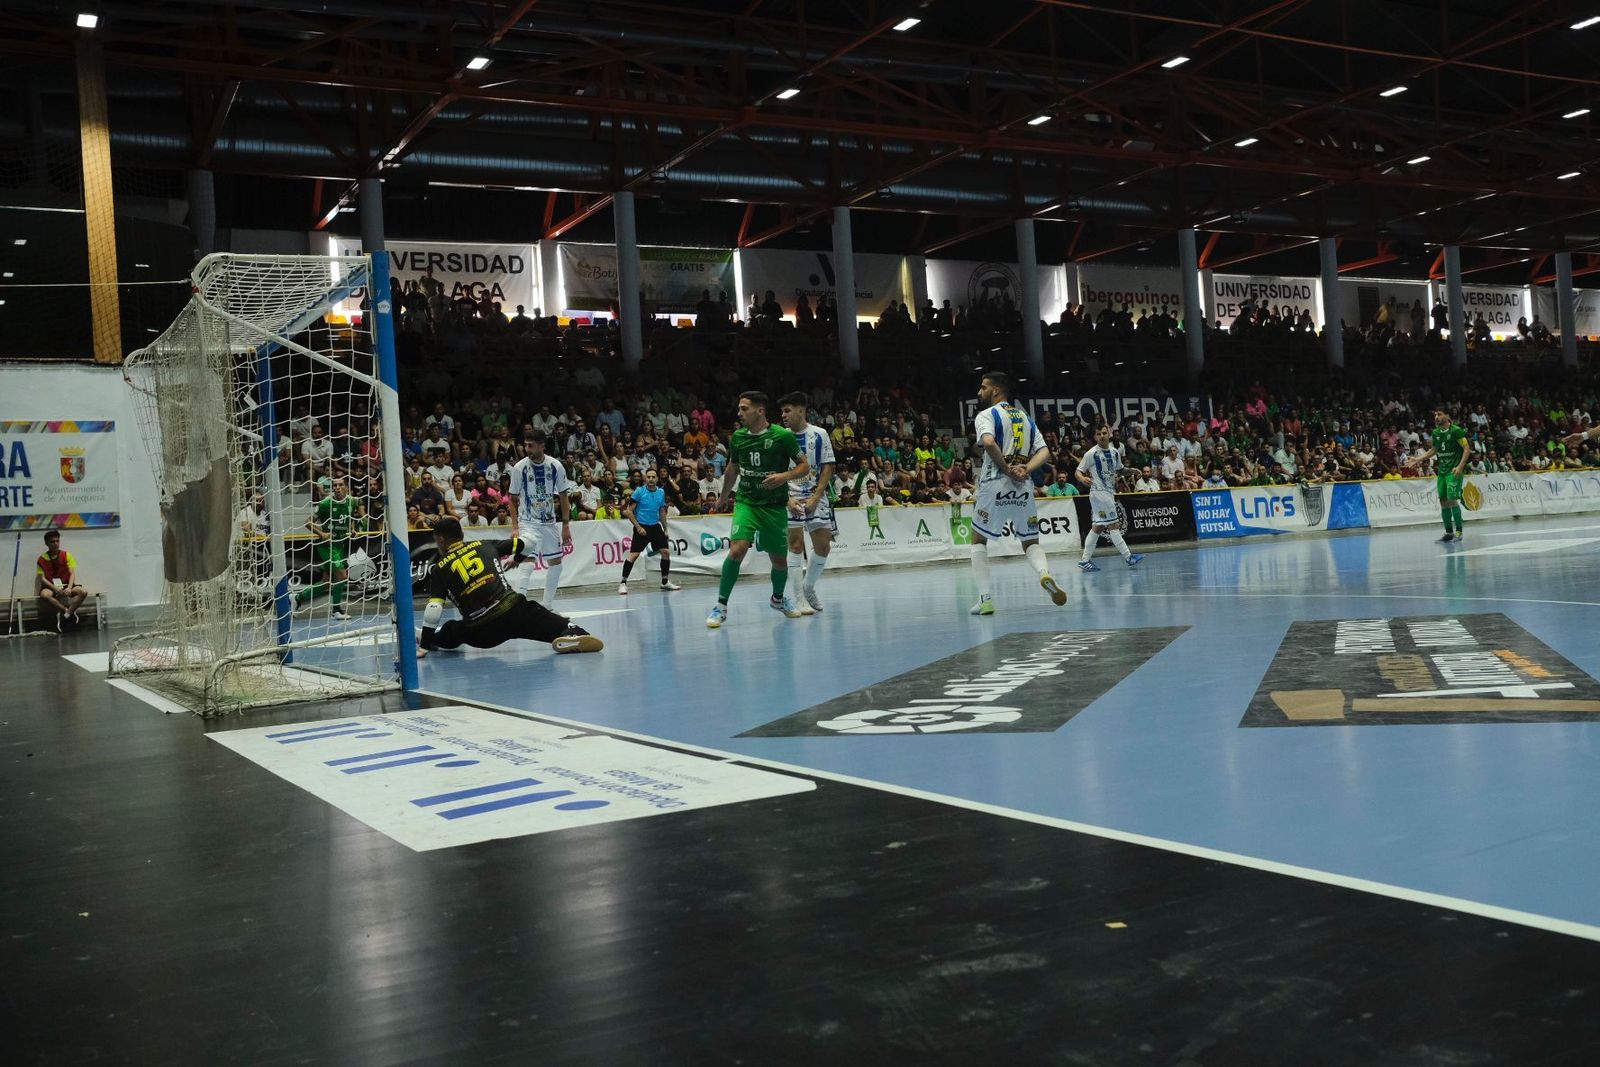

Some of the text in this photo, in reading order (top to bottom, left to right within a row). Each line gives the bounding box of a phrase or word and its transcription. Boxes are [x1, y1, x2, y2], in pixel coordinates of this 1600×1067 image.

[344, 249, 524, 273] VERSIDAD
[669, 262, 703, 272] GRATIS
[1080, 283, 1179, 308] iberoquinoa
[1215, 282, 1310, 299] UNIVERSIDAD
[1441, 291, 1520, 306] UVERSIDAD
[1216, 303, 1236, 317] DE
[1012, 422, 1024, 450] 5
[749, 451, 761, 467] 18
[43, 484, 105, 495] Ayuntamiento
[1195, 496, 1221, 506] SIN TI
[1132, 506, 1179, 518] UNIVERSIDAD
[1198, 508, 1230, 520] NO HAY
[1134, 519, 1144, 528] DE
[1200, 521, 1236, 533] FUTSAL
[438, 553, 456, 569] DANI
[450, 549, 485, 584] 15
